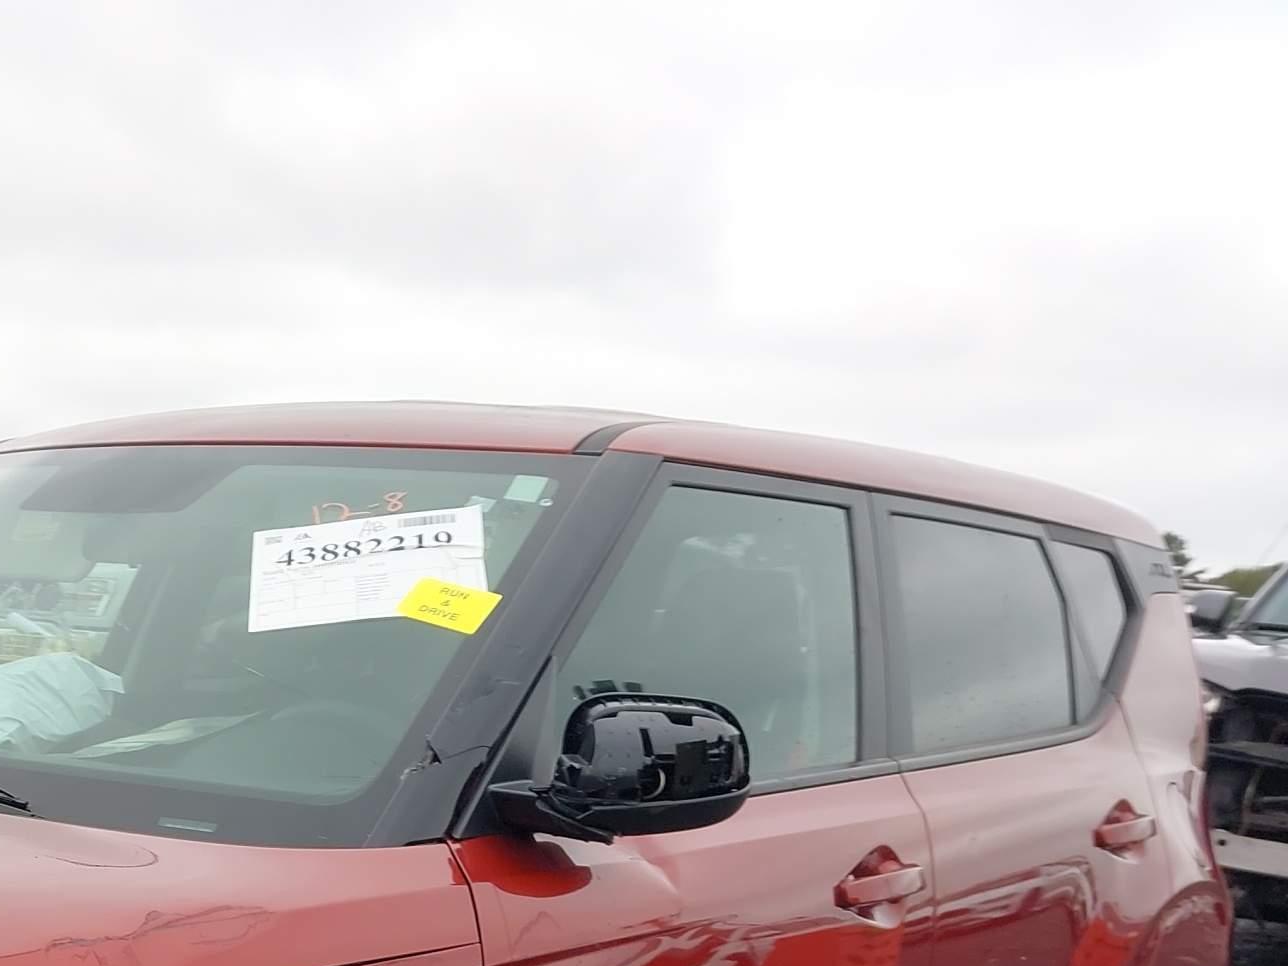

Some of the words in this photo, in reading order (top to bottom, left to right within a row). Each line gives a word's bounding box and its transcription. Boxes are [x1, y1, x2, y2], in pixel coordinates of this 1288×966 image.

[275, 530, 453, 567] 43882219
[439, 587, 471, 600] RUN
[417, 604, 461, 622] DRIVE
